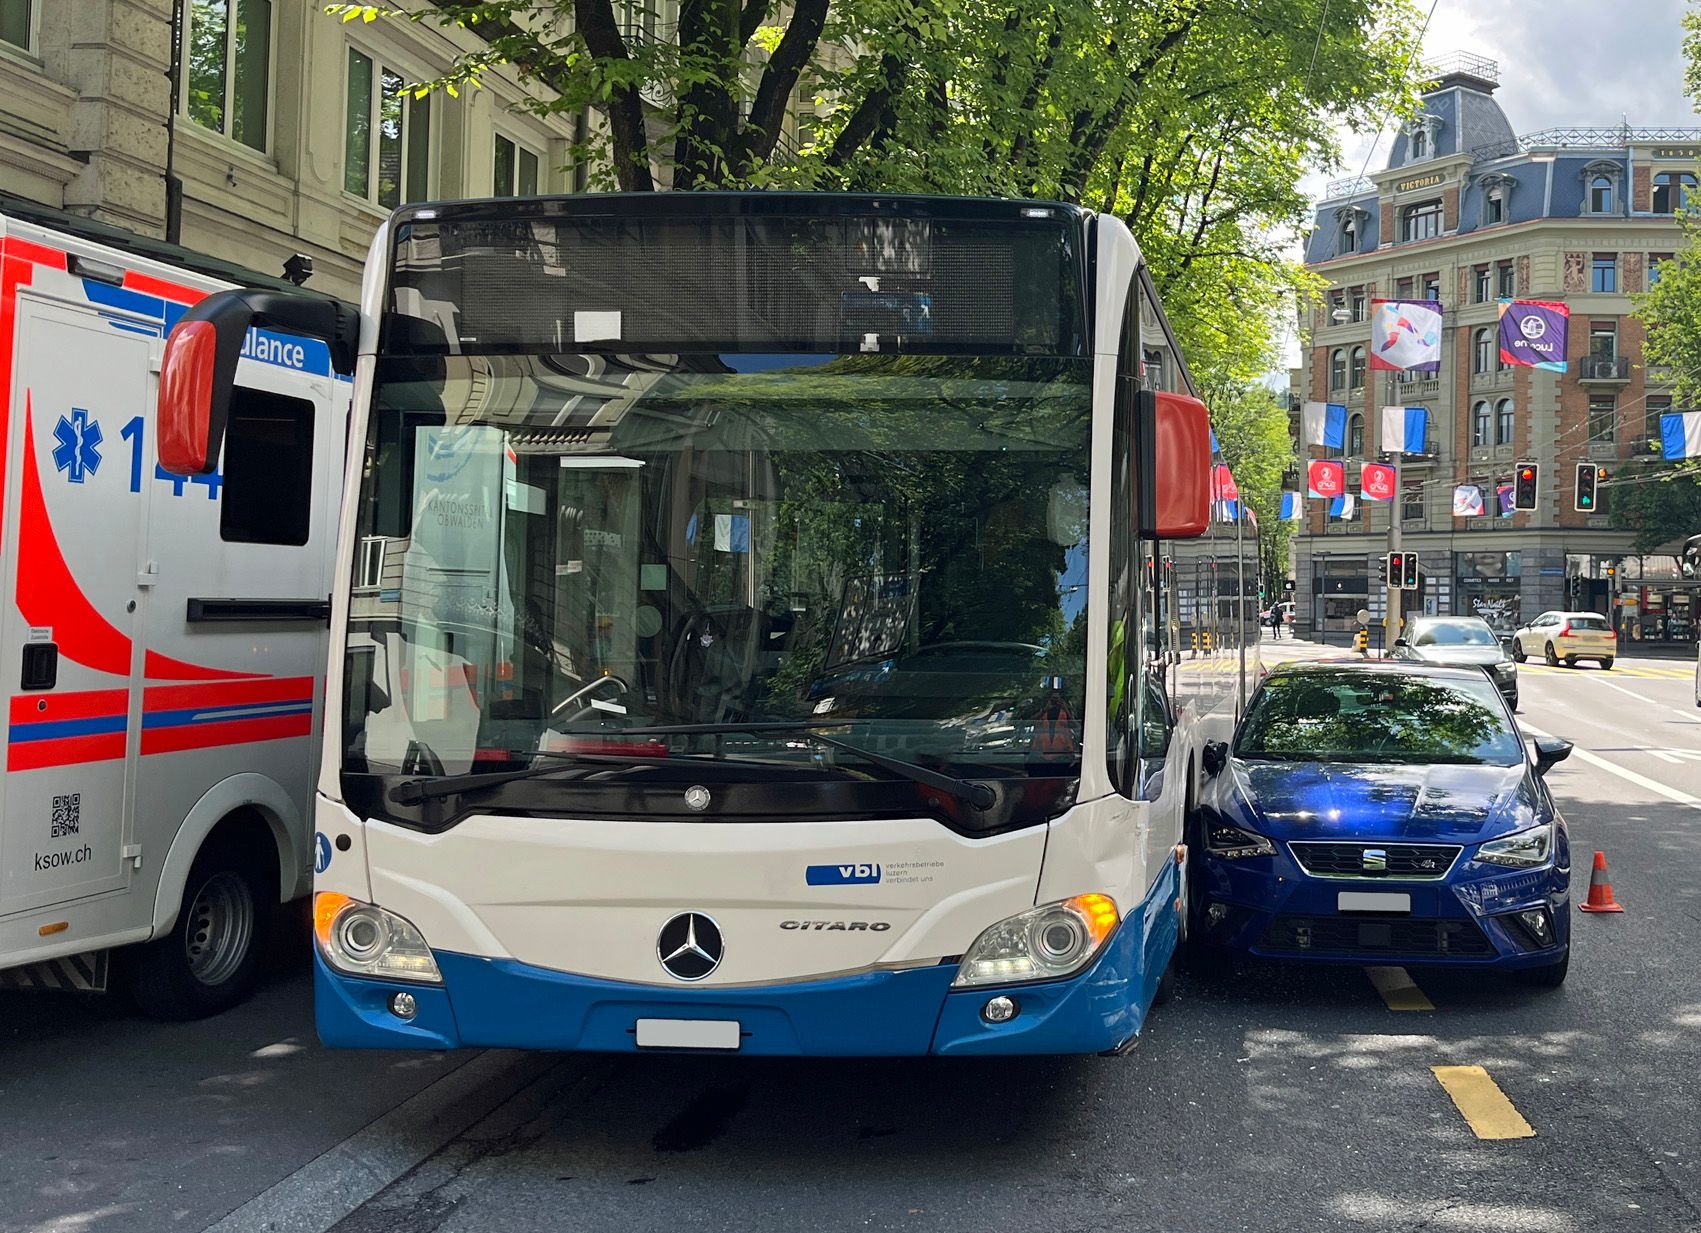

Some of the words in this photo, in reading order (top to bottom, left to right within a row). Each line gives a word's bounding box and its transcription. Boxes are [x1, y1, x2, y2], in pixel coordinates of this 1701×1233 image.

[1400, 175, 1440, 191] VICTORIA
[34, 843, 92, 871] ksow.ch
[838, 863, 879, 878] vbl
[885, 861, 945, 869] verkehrsbetriebe
[885, 869, 908, 877] luzern
[885, 876, 919, 884] verbindet
[779, 920, 892, 932] CITARO
